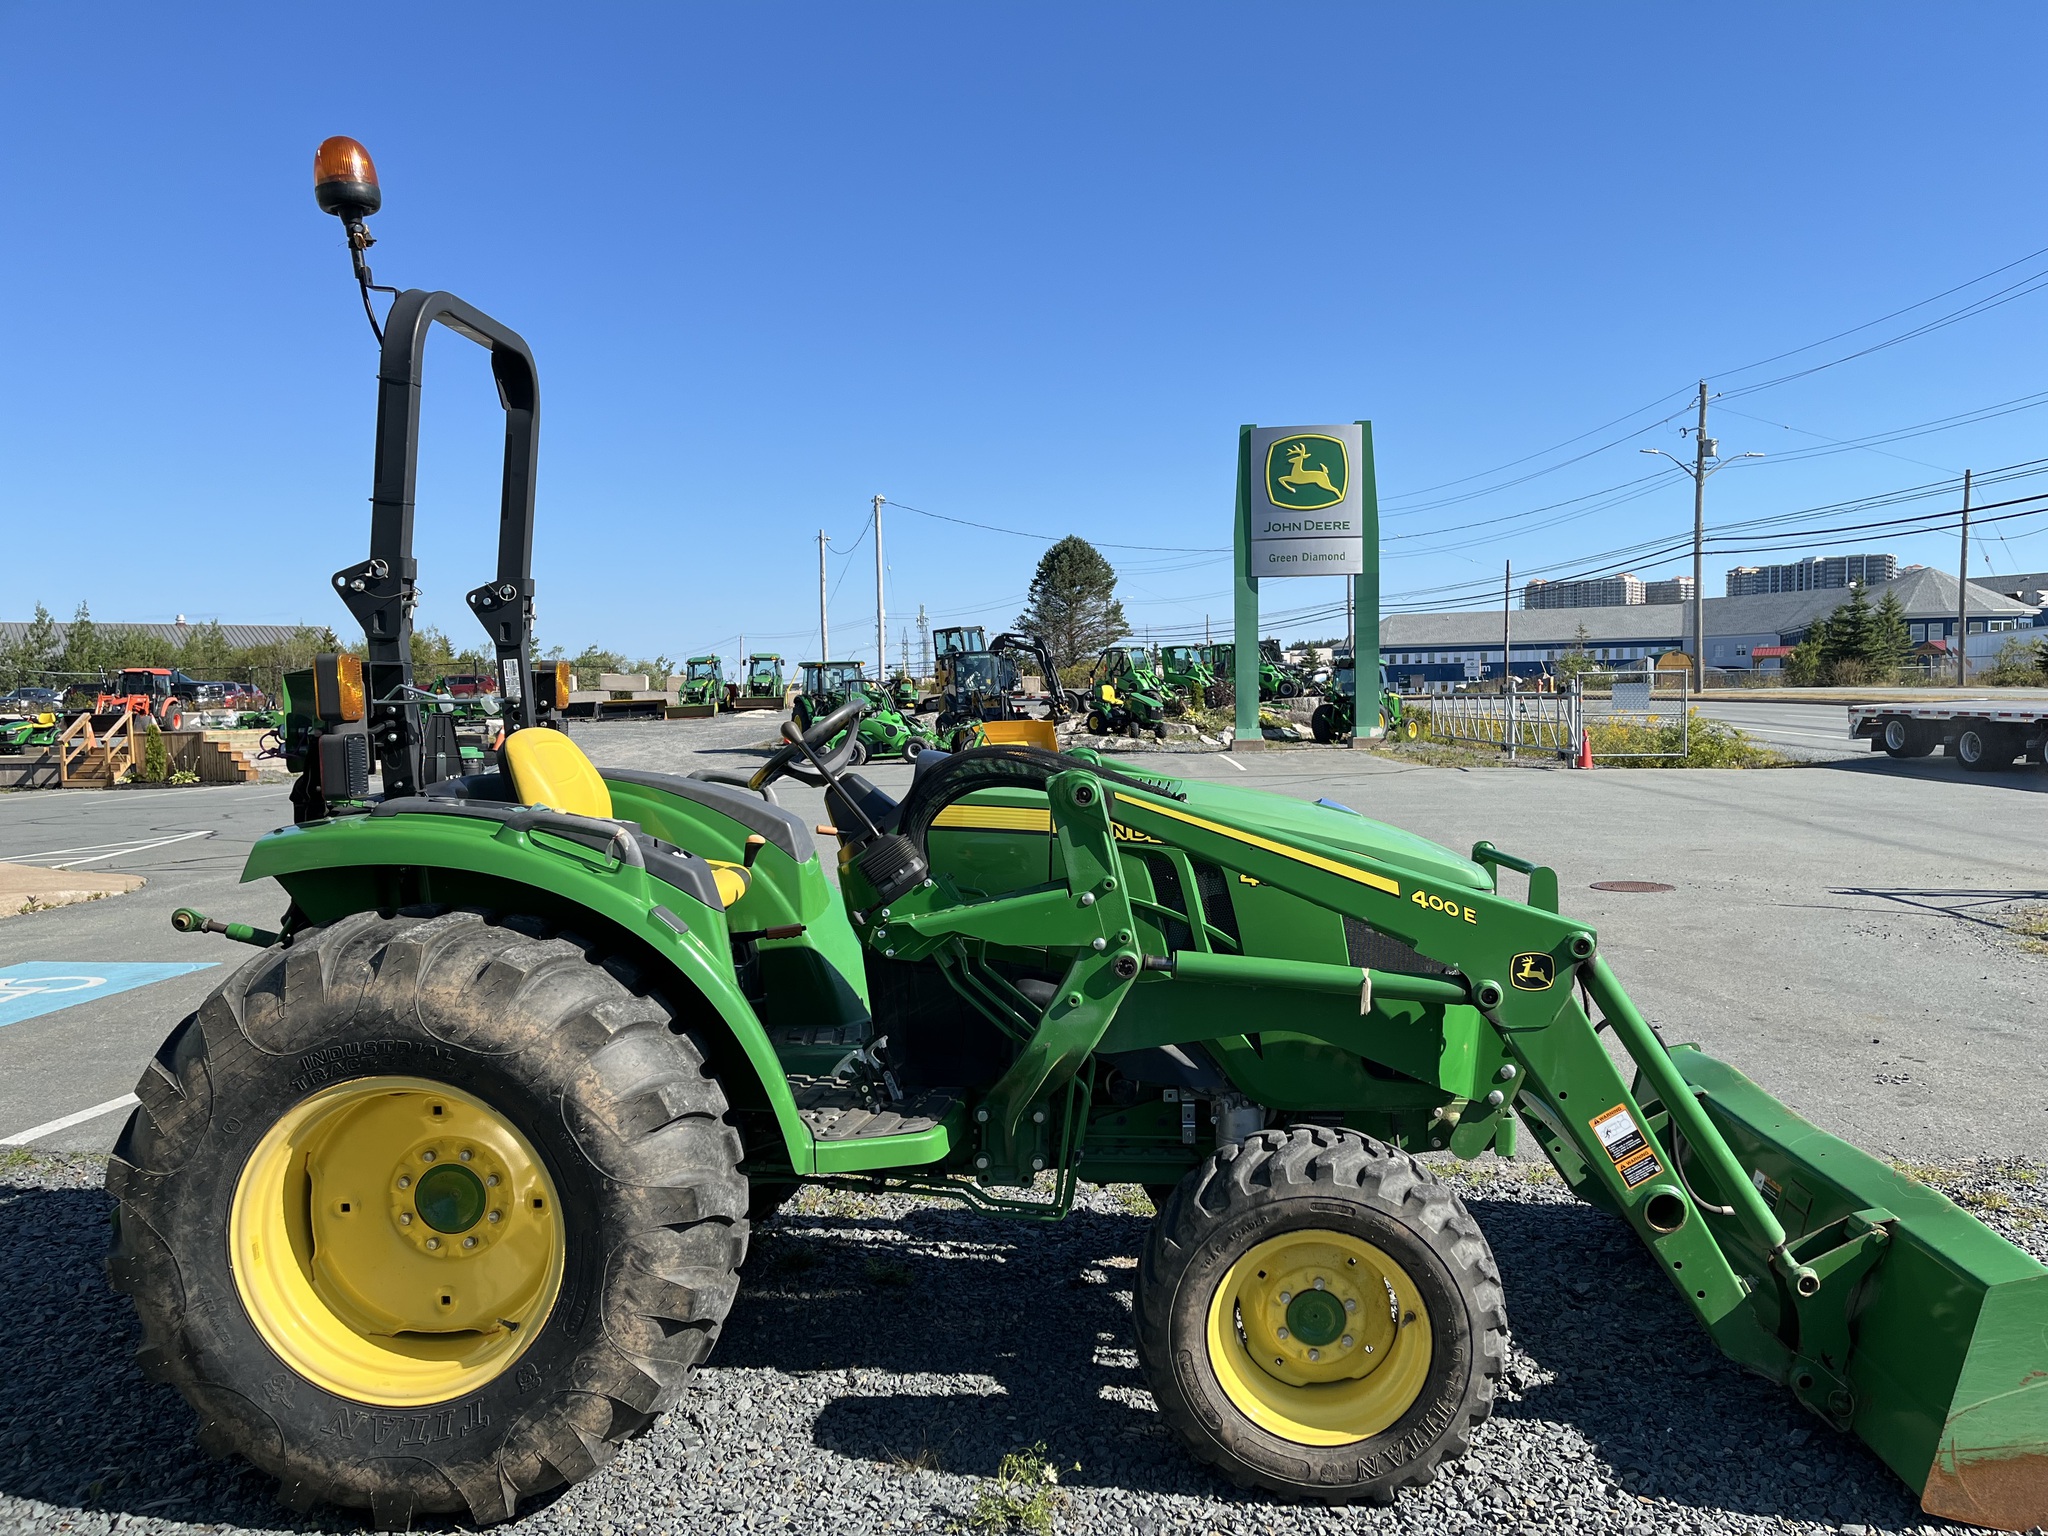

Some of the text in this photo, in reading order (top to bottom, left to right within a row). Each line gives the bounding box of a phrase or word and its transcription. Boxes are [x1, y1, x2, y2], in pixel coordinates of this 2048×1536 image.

[1263, 520, 1350, 533] JOHN DEERE
[1268, 552, 1346, 563] Green Diamond
[1411, 890, 1477, 925] 400 E
[300, 1039, 456, 1071] INDUSTRIAL
[289, 1055, 413, 1092] TRACTOR
[1599, 1107, 1622, 1121] WARNING
[320, 1398, 490, 1447] TITAN
[1357, 1398, 1457, 1482] TITAN
